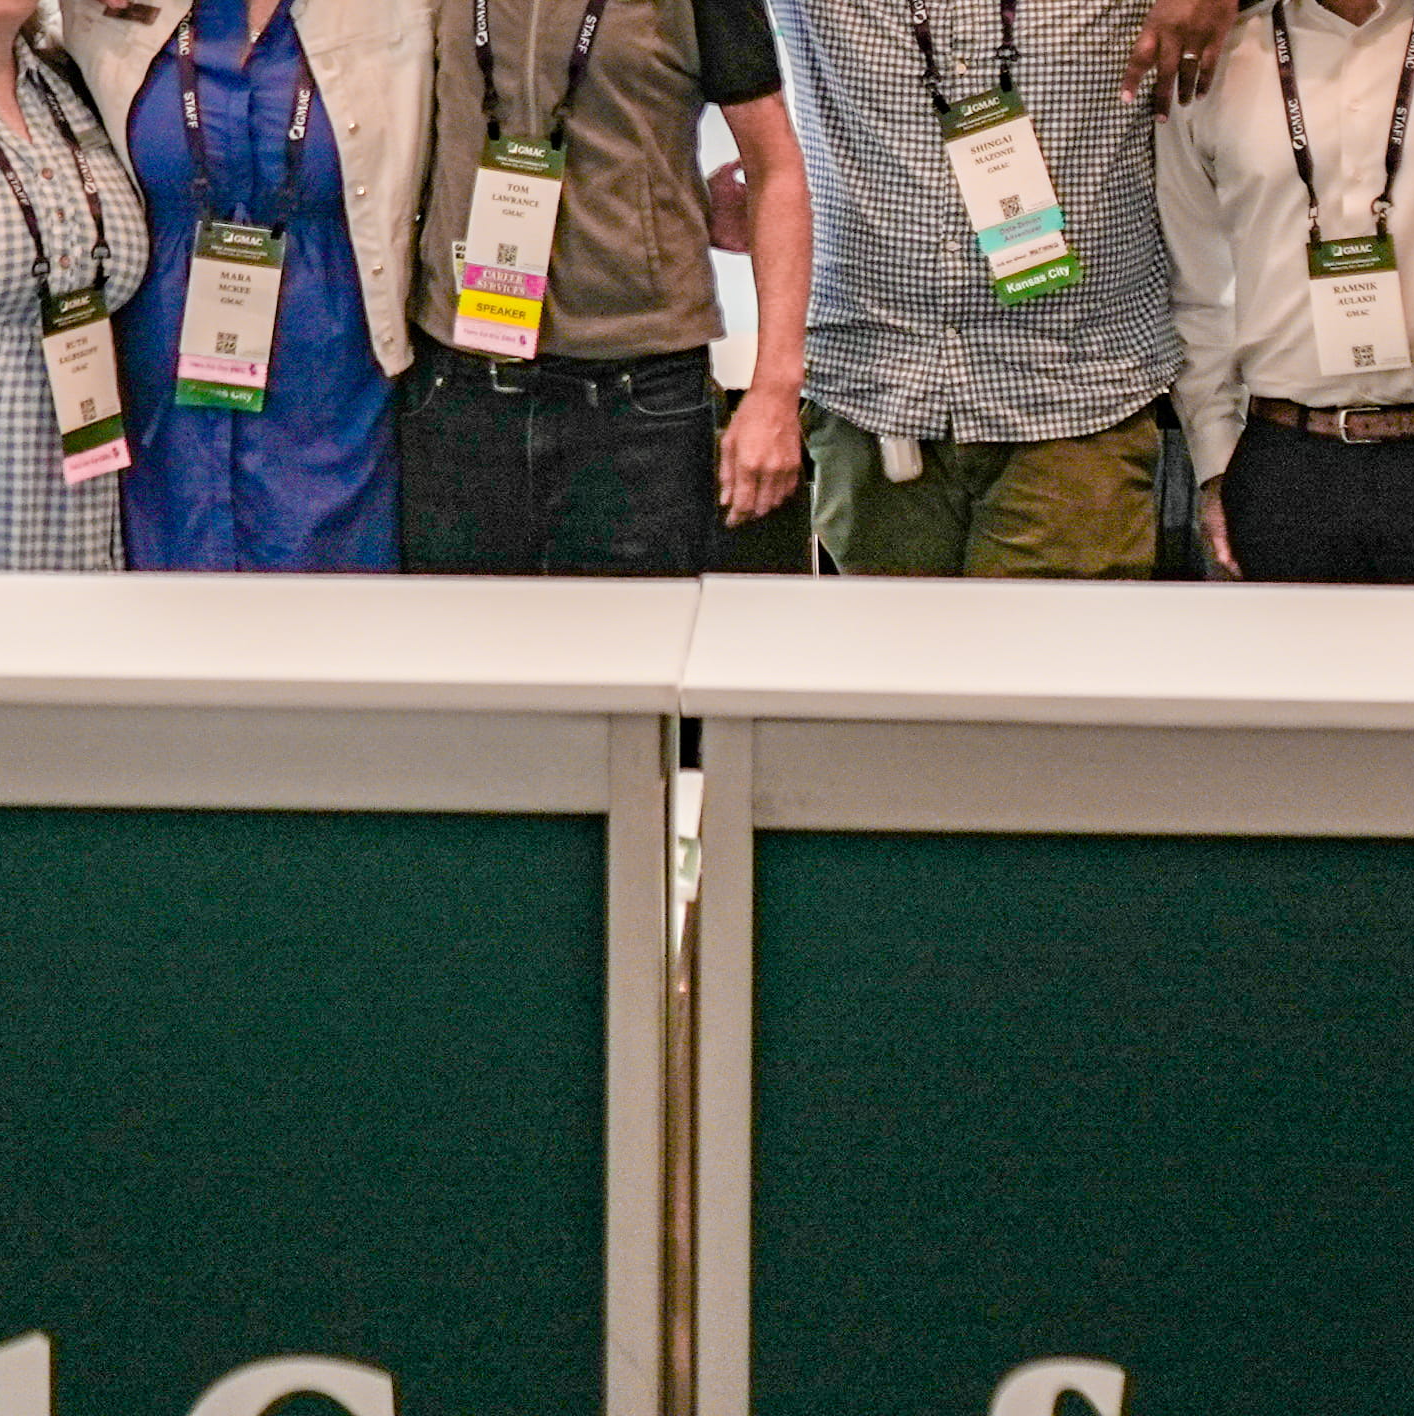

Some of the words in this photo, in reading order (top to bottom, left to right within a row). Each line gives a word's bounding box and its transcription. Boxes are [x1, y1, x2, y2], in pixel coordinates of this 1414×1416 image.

[578, 14, 598, 55] STAFF
[1276, 30, 1289, 64] STAFF
[184, 91, 199, 129] STAFF
[296, 89, 311, 126] GMAC
[972, 97, 1000, 113] GMAC
[1288, 98, 1303, 134] GMAC
[1392, 107, 1407, 145] STAFF
[517, 147, 546, 159] GMAC
[970, 135, 1013, 155] SHINGAI
[507, 183, 529, 195] TOM
[491, 194, 540, 209] LAWRANCE
[502, 208, 525, 218] GMAC
[233, 235, 263, 247] GMAC
[1343, 244, 1373, 255] GMAC
[1006, 273, 1047, 294] Kansas
[1047, 264, 1070, 282] City
[1333, 282, 1378, 295] RAMNIK
[476, 301, 527, 321] SPEAKER
